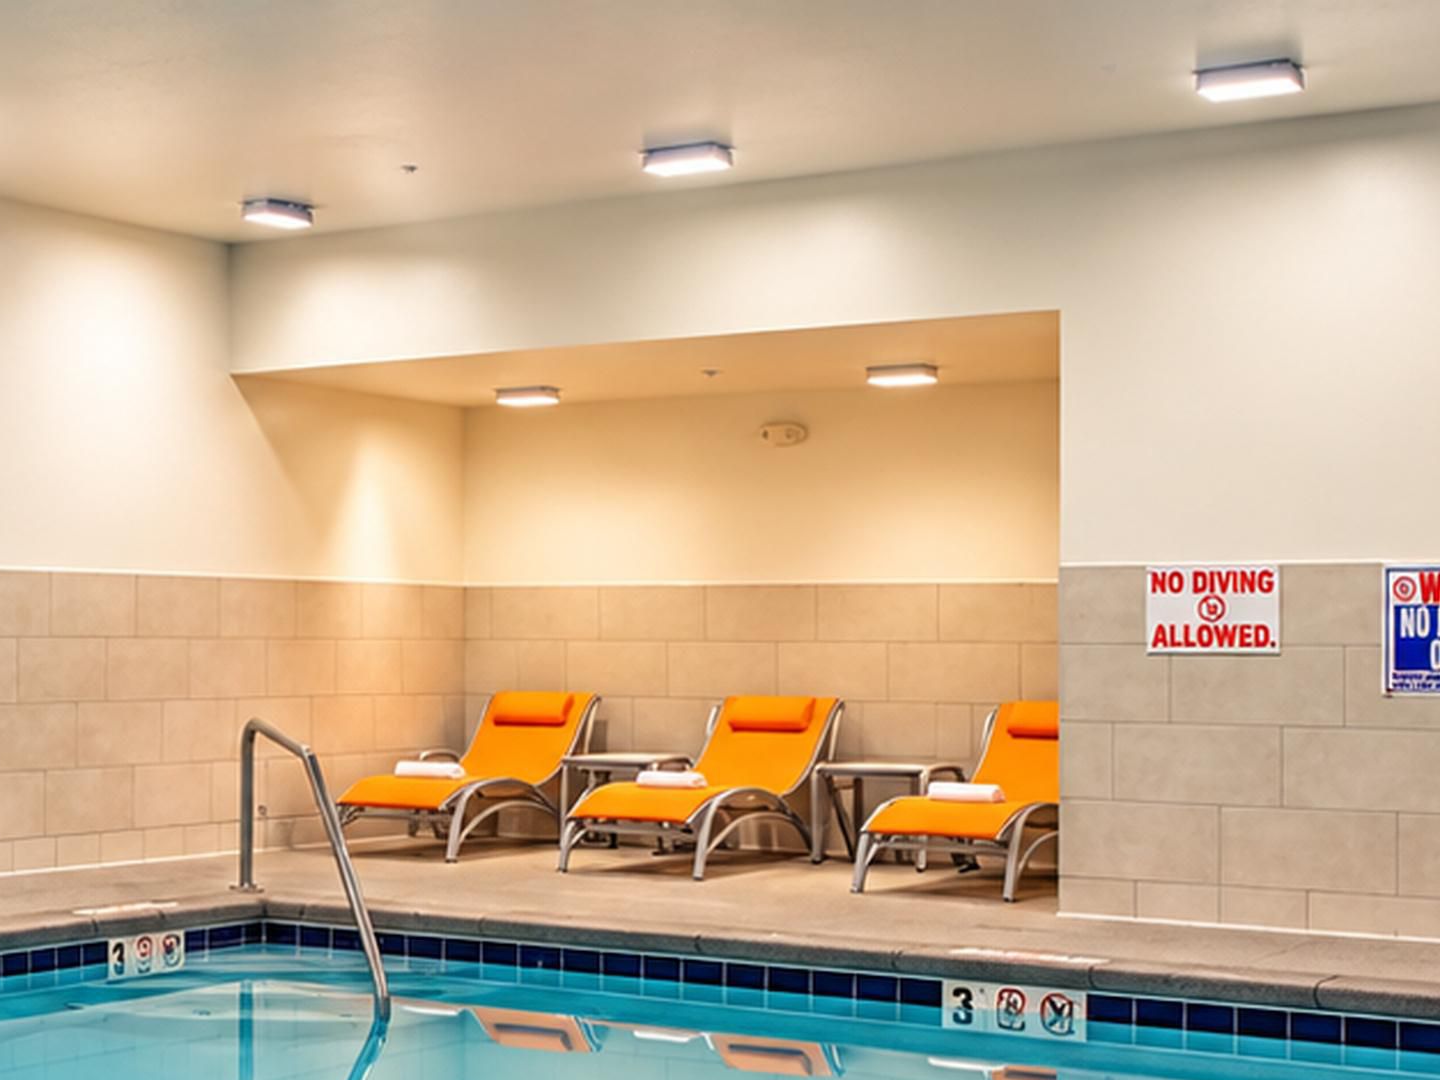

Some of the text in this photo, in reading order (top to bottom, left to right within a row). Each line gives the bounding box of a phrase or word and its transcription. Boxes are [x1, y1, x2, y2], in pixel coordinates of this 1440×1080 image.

[1151, 571, 1274, 593] NO DIVING
[1401, 607, 1430, 638] NO
[1151, 623, 1276, 648] ALLOWED.
